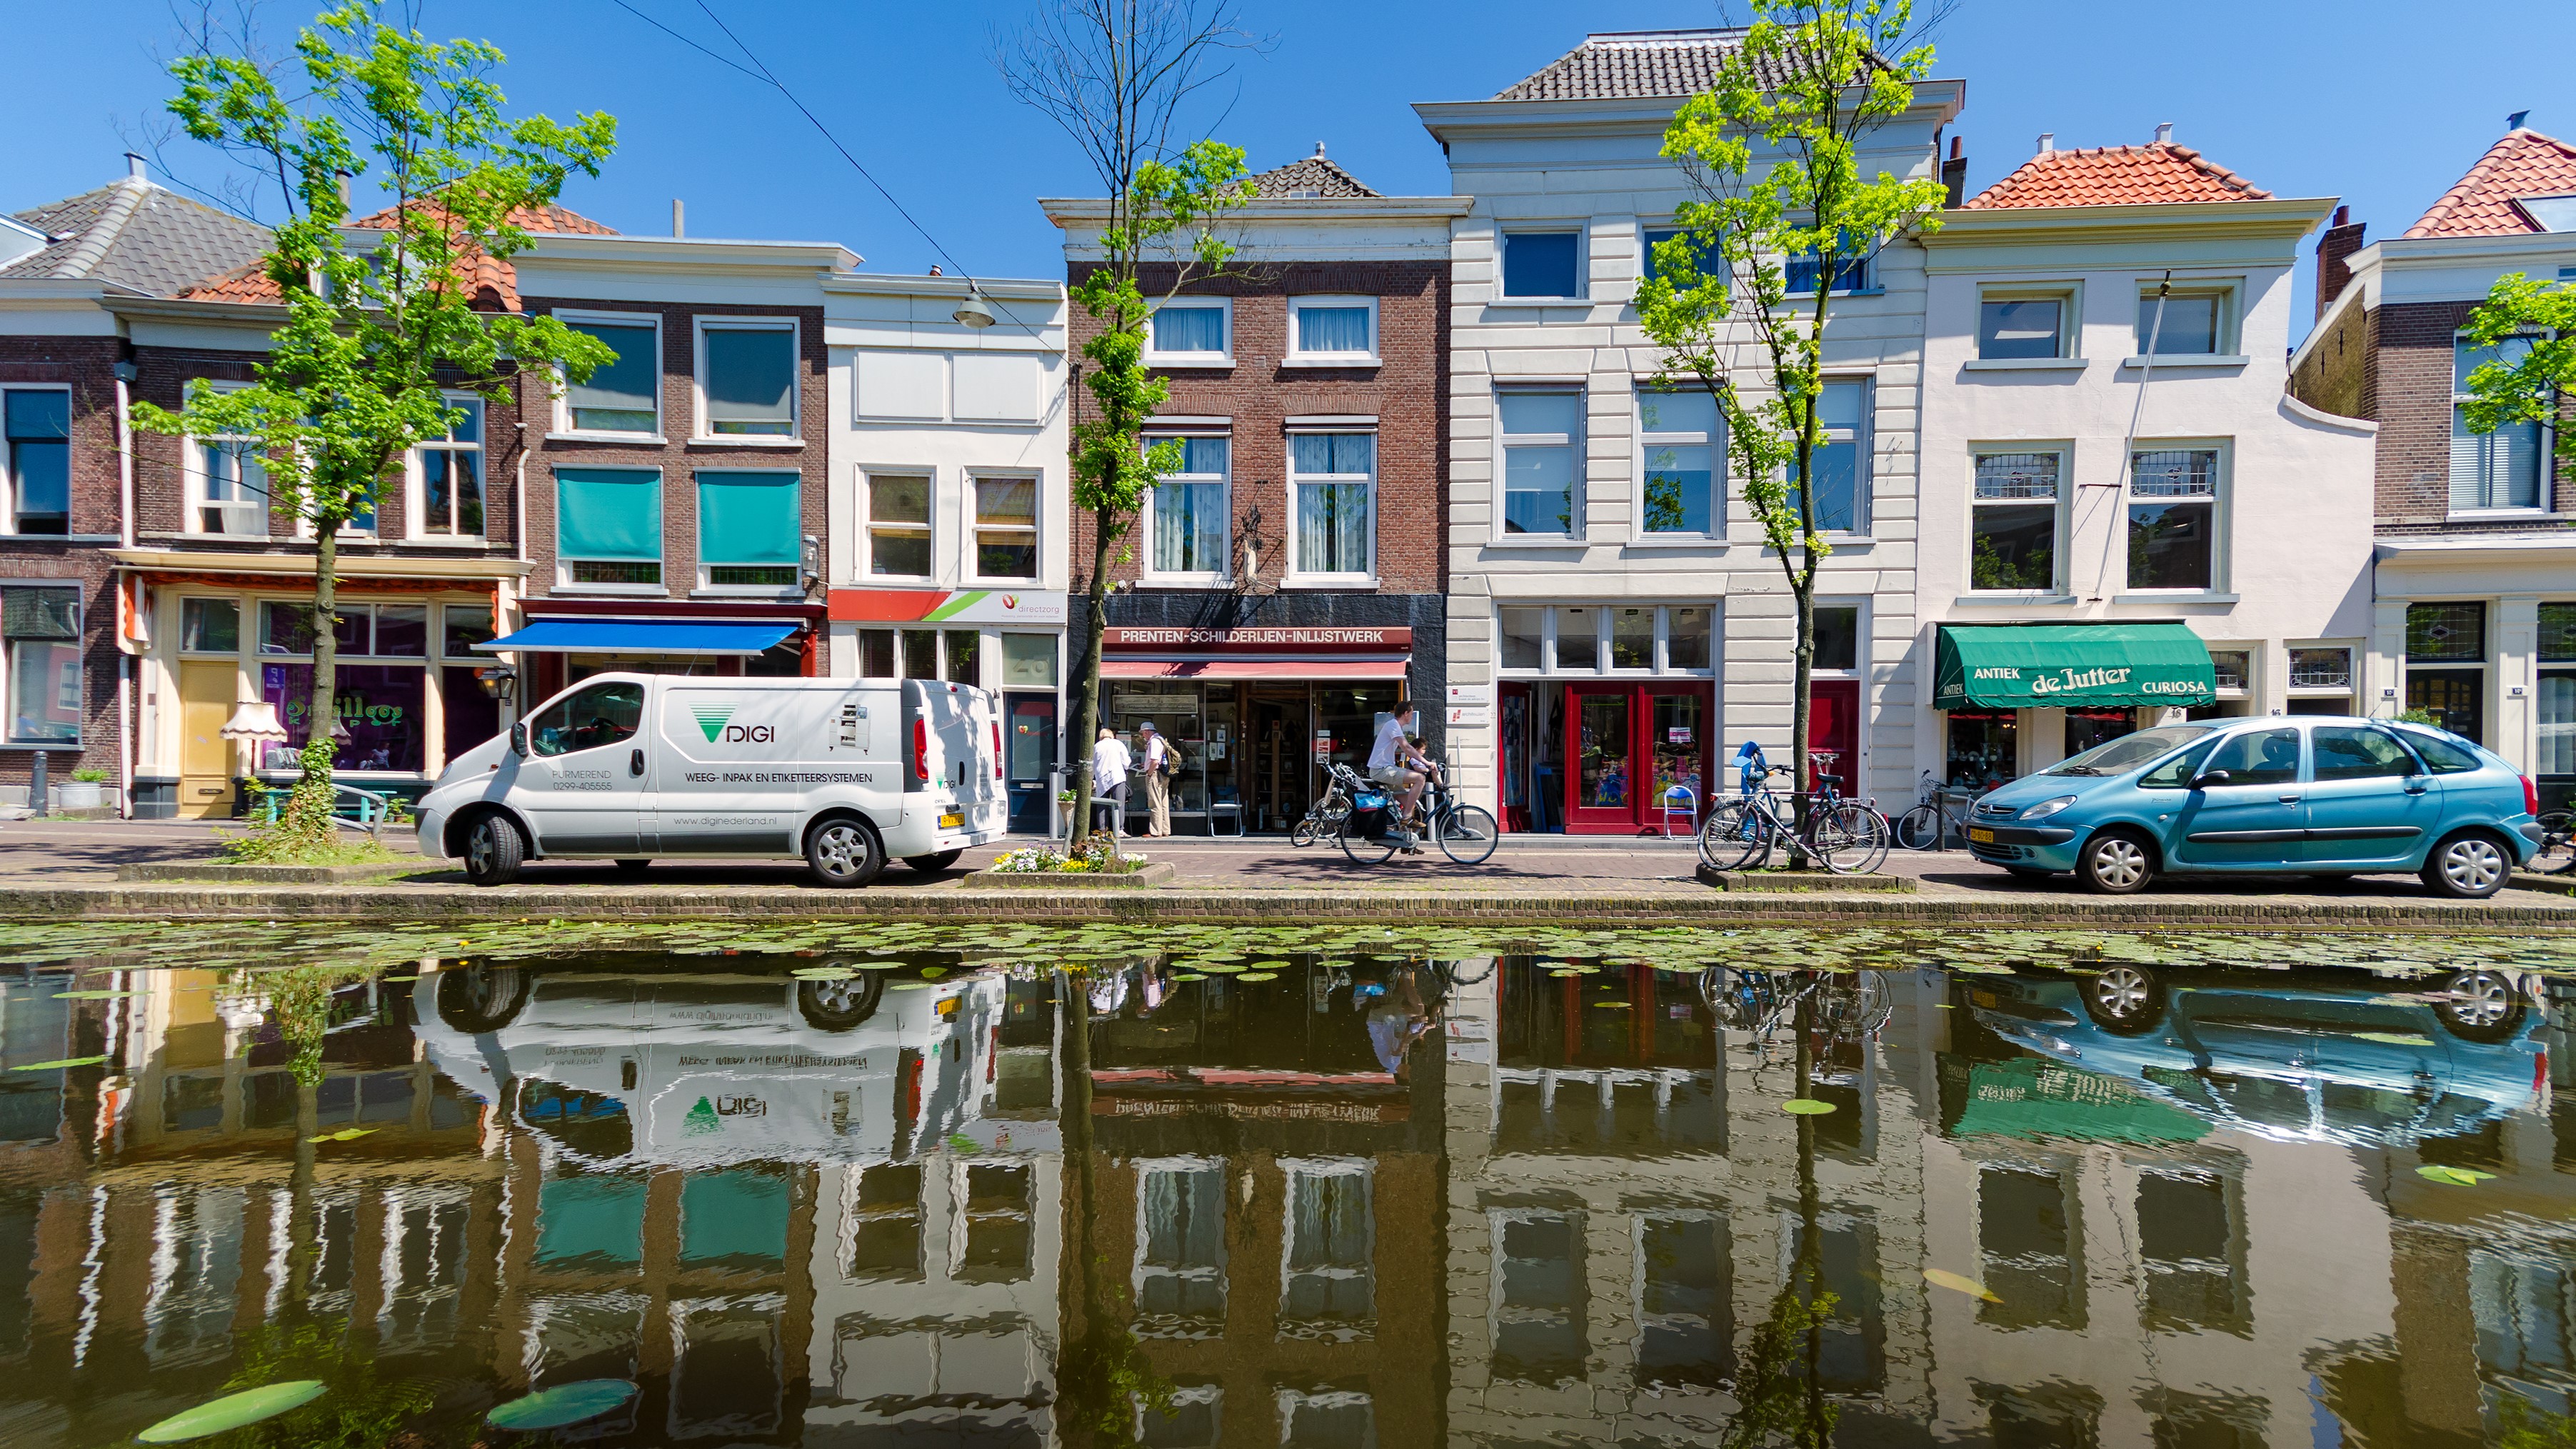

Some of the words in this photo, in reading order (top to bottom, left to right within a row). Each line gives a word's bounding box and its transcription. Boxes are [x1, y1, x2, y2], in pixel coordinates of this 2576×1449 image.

[1018, 606, 1060, 614] directzorg
[1121, 630, 1383, 643] PRENTEN-SCHILDERIJEN-INLIJSTWERK
[1974, 667, 2020, 680] ANTIEK
[2033, 673, 2060, 693] de
[2061, 667, 2131, 691] Jutter
[1943, 683, 1963, 696] ANTIEK
[2142, 681, 2207, 693] CURIOSA
[726, 726, 775, 743] DIGI
[552, 771, 612, 779] PURMEREND
[685, 773, 720, 783] WEEG-
[723, 773, 753, 783] INPAK
[756, 773, 769, 783] EN
[772, 773, 873, 783] ETIKETTEERSYSTEMEN
[553, 782, 613, 791] 0299-405555
[943, 780, 956, 789] DIGI
[673, 817, 777, 827] www.diginederland.nl
